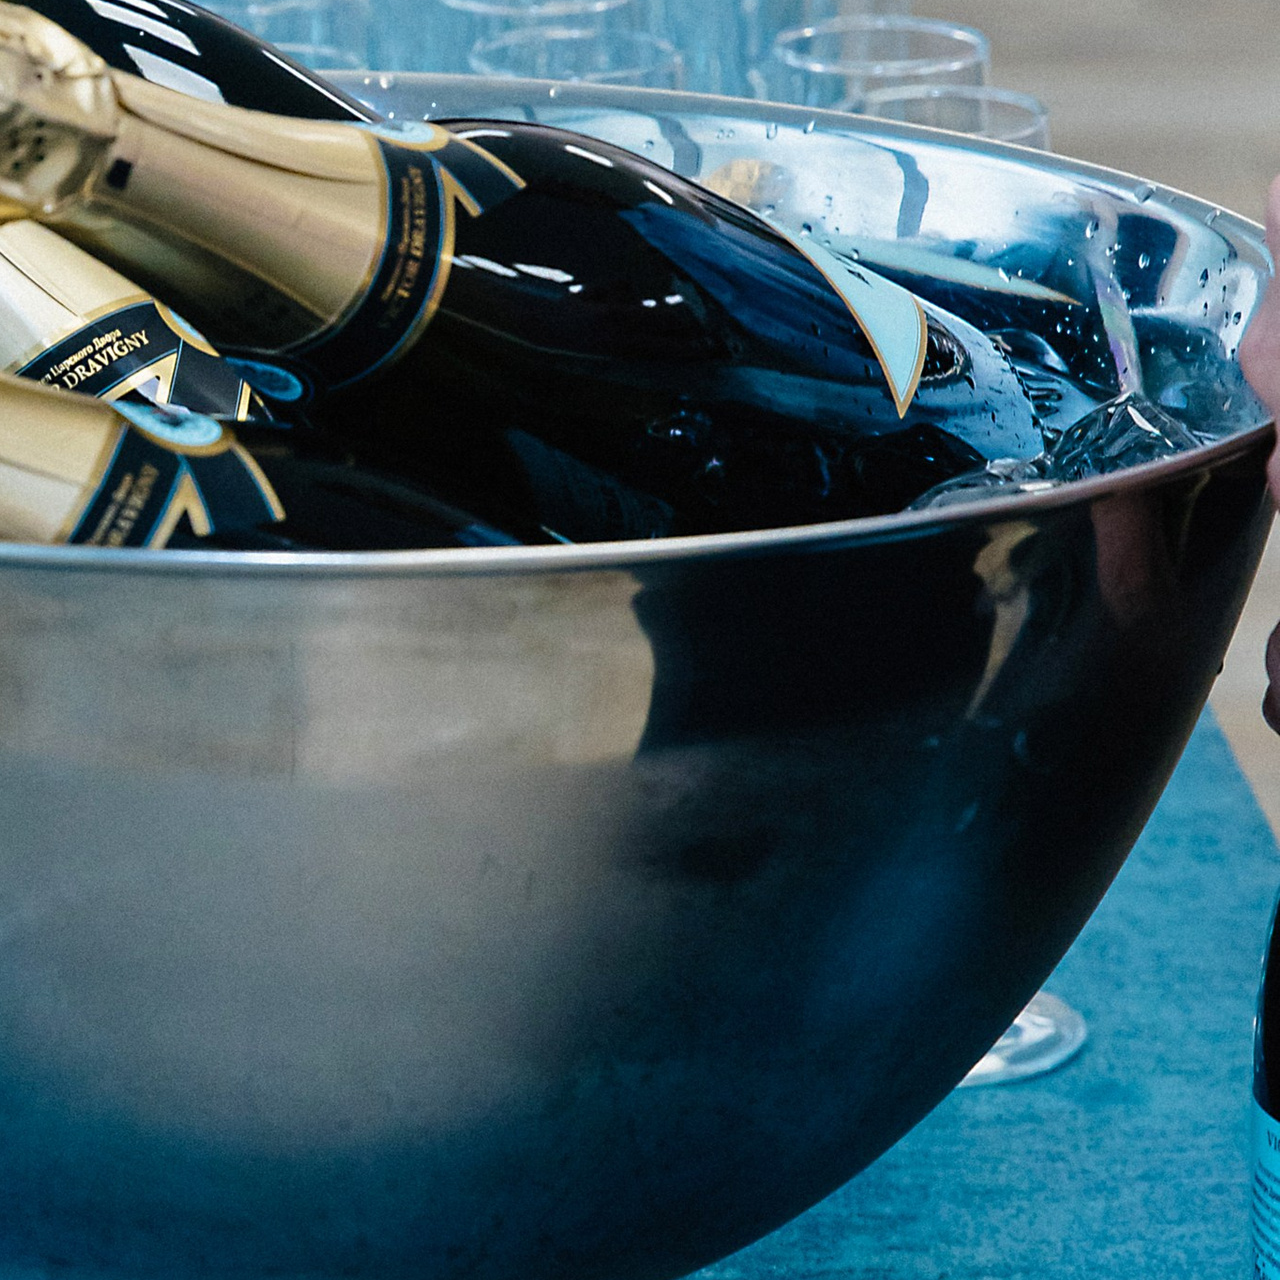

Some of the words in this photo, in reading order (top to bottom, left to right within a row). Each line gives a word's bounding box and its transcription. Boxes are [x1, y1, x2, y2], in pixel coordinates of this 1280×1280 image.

[50, 344, 94, 377] Царского
[92, 329, 122, 351] Двора
[62, 330, 149, 389] DRAVIGNY
